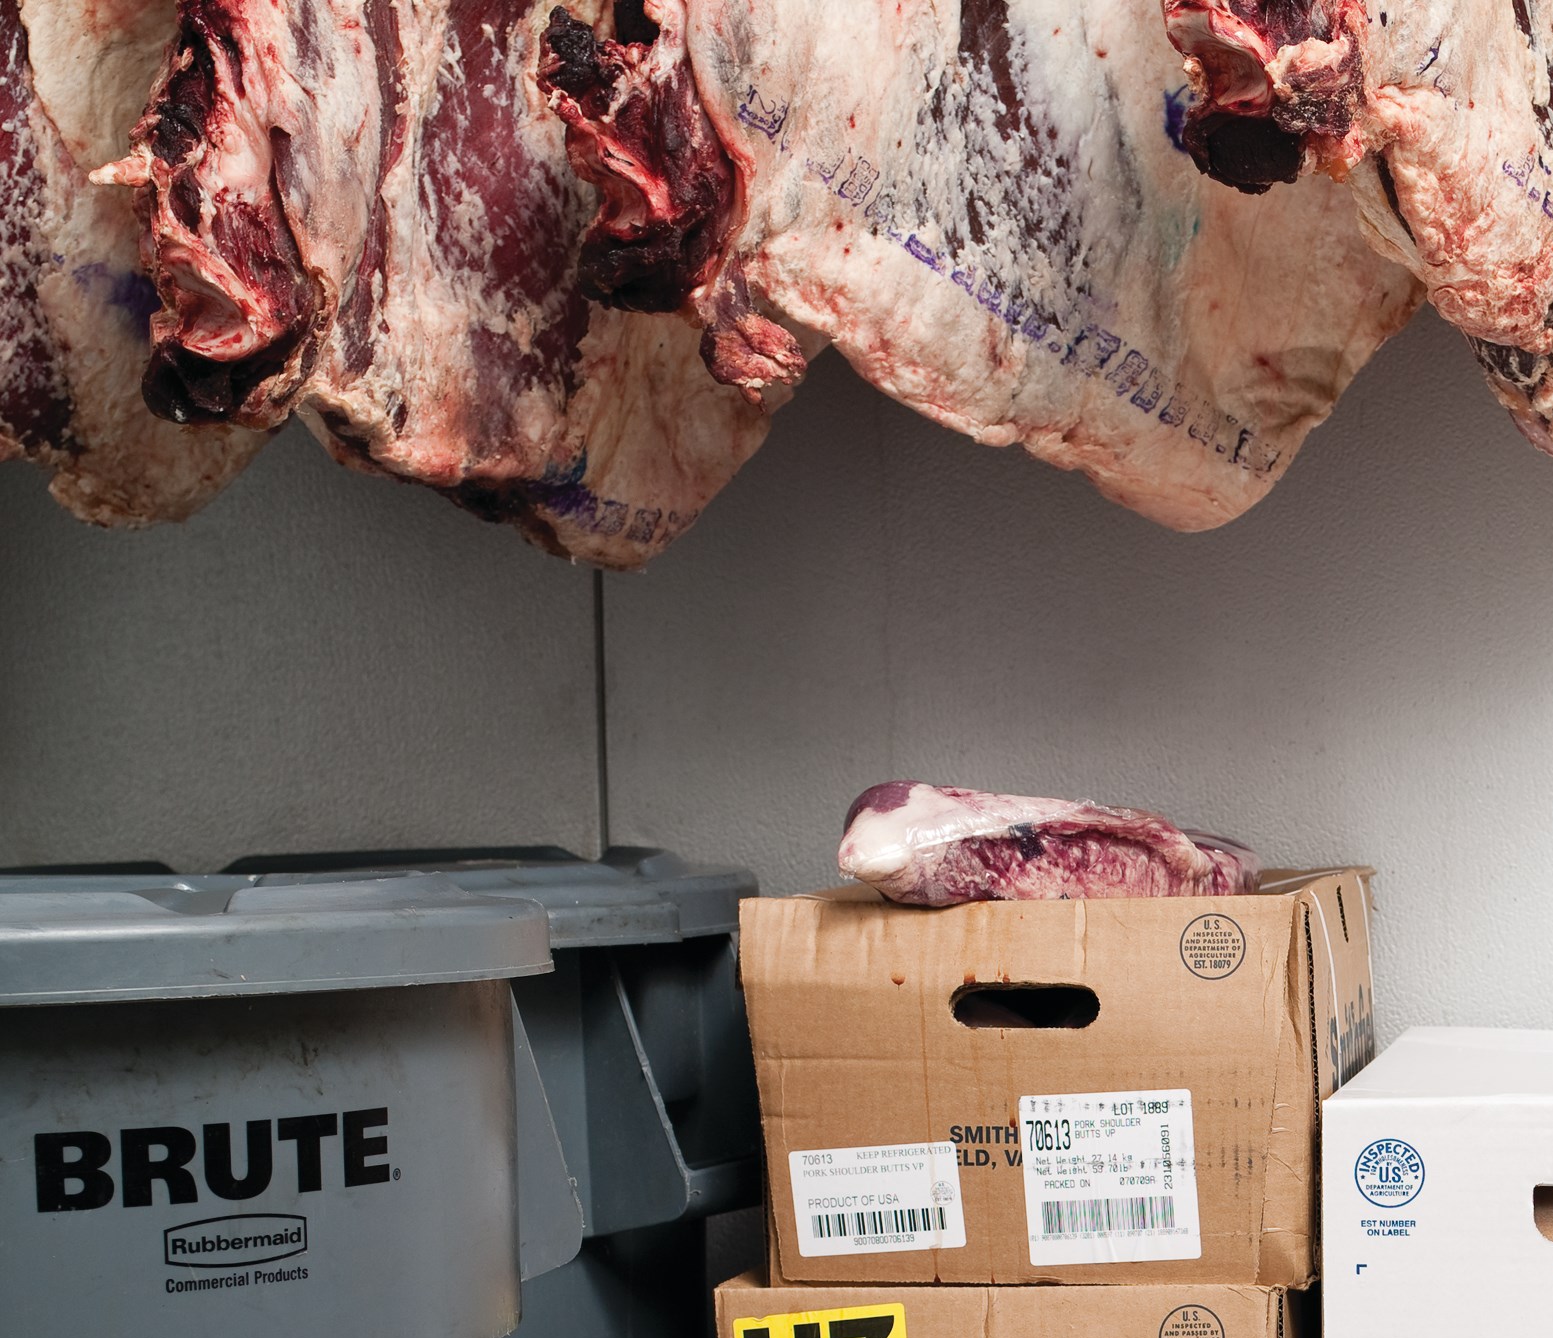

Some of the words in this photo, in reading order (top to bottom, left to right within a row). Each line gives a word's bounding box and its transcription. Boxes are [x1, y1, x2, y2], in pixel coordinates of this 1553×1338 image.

[1209, 959, 1232, 969] 18079
[1113, 1102, 1134, 1116] LOT
[1142, 1100, 1169, 1115] 1889
[1074, 1119, 1096, 1129] PORK
[1099, 1117, 1141, 1128] SHOULDER
[949, 1125, 1019, 1144] SMITH
[1026, 1119, 1071, 1151] 70613
[1074, 1129, 1101, 1139] BUTTS
[1105, 1128, 1116, 1138] VP
[34, 1106, 391, 1213] BRUTE
[802, 1153, 833, 1166] 70613
[856, 1150, 880, 1160] KEEP
[882, 1146, 951, 1159] REFRIGERATED
[1359, 1142, 1420, 1173] INSPECTED
[803, 1168, 828, 1178] PORK
[829, 1166, 879, 1177] SHOULDER
[880, 1164, 910, 1173] BUTTS
[911, 1162, 925, 1172] VP
[1378, 1166, 1404, 1183] U.S.
[1044, 1179, 1075, 1190] PACKED
[808, 1196, 857, 1209] PRODUCT
[860, 1195, 876, 1207] OF
[878, 1194, 900, 1205] USA
[1360, 1219, 1377, 1228] EST
[1379, 1219, 1417, 1228] NUMBER
[1366, 1228, 1380, 1236] ON
[1381, 1228, 1410, 1236] LABEL
[171, 1226, 302, 1255] Rubbermaid
[165, 1271, 250, 1294] Commercial
[254, 1266, 309, 1286] Products
